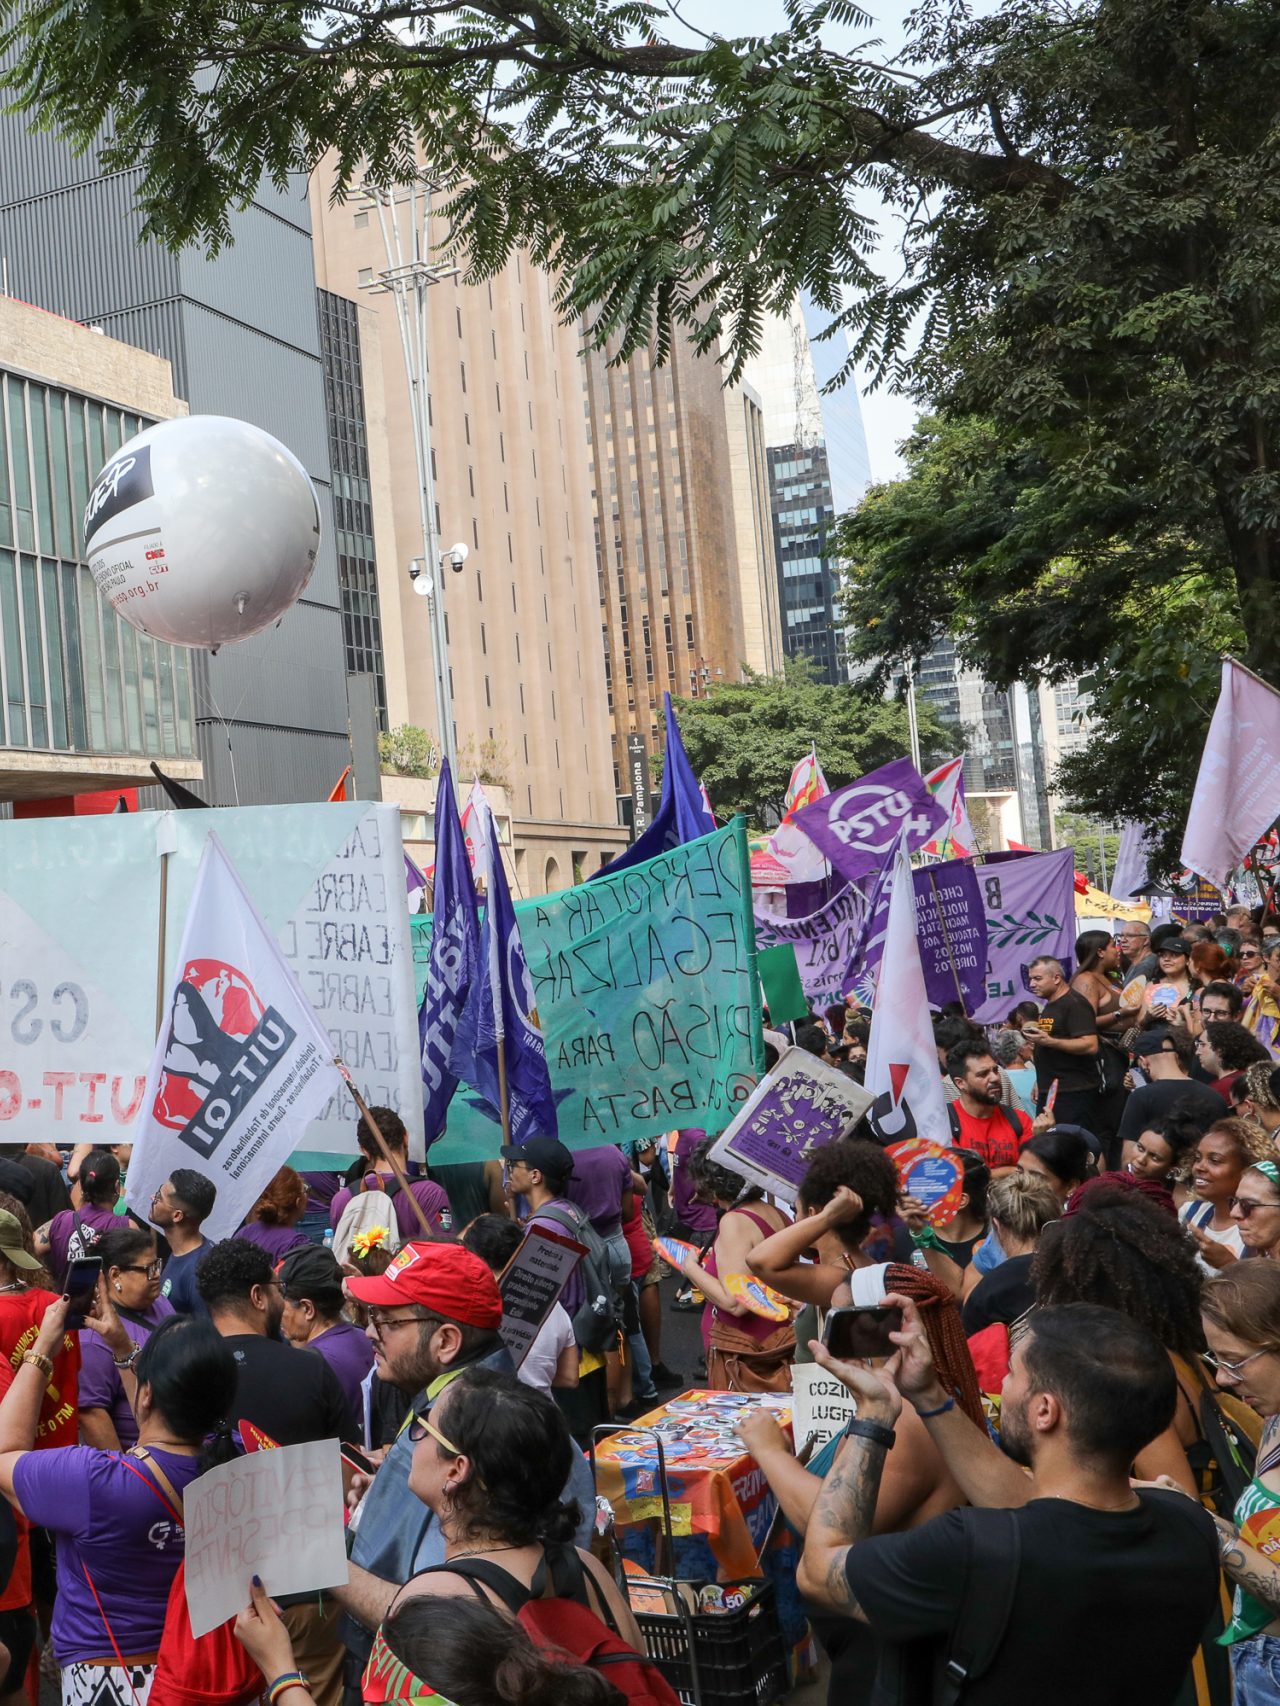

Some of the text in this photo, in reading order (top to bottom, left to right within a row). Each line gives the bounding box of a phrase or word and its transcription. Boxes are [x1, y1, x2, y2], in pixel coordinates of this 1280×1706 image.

[634, 762, 645, 827] Pamplona R.
[828, 790, 913, 844] PSTU
[48, 1420, 56, 1432] O
[56, 1403, 74, 1424] FIM
[725, 1592, 745, 1610] 50
